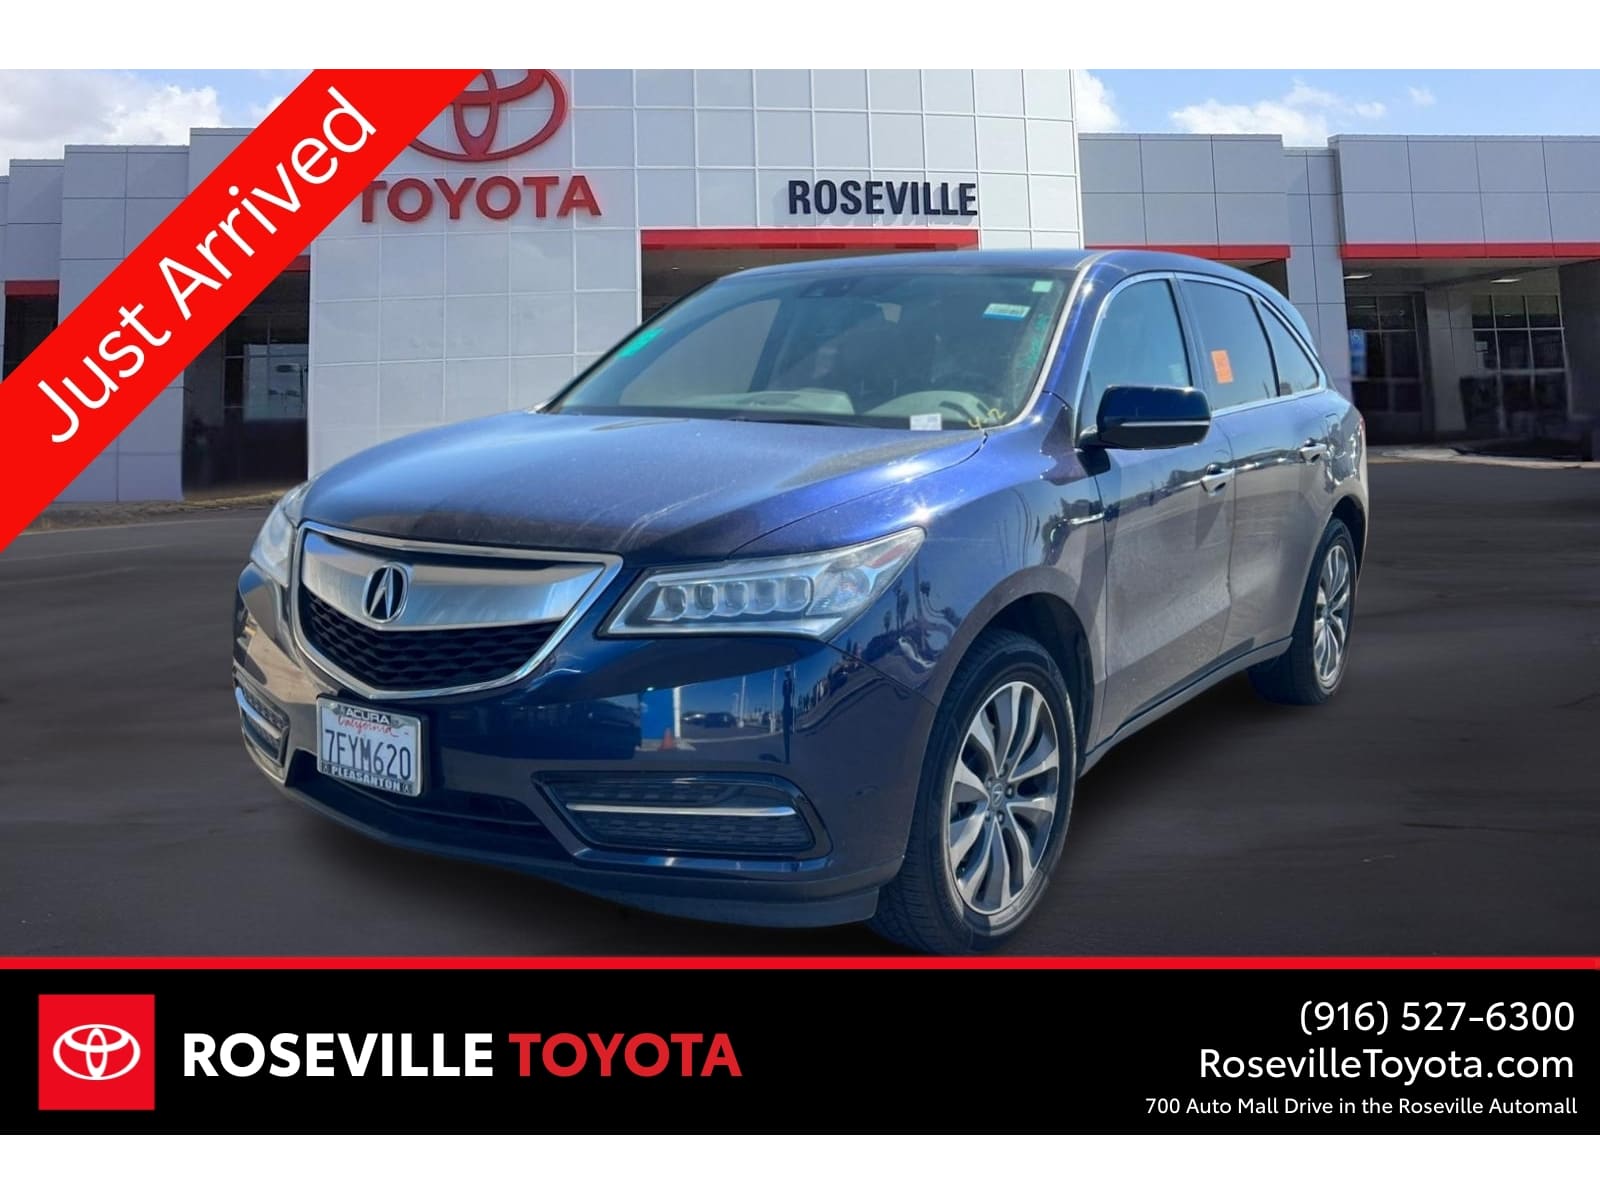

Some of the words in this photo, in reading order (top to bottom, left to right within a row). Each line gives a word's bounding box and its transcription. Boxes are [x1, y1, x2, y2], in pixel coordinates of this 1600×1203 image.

[361, 175, 602, 223] TOYOTA
[788, 180, 978, 216] ROSEVILLE
[346, 707, 390, 725] ACURA
[324, 728, 412, 781] 7FYM620
[330, 764, 401, 792] PLEASANTON
